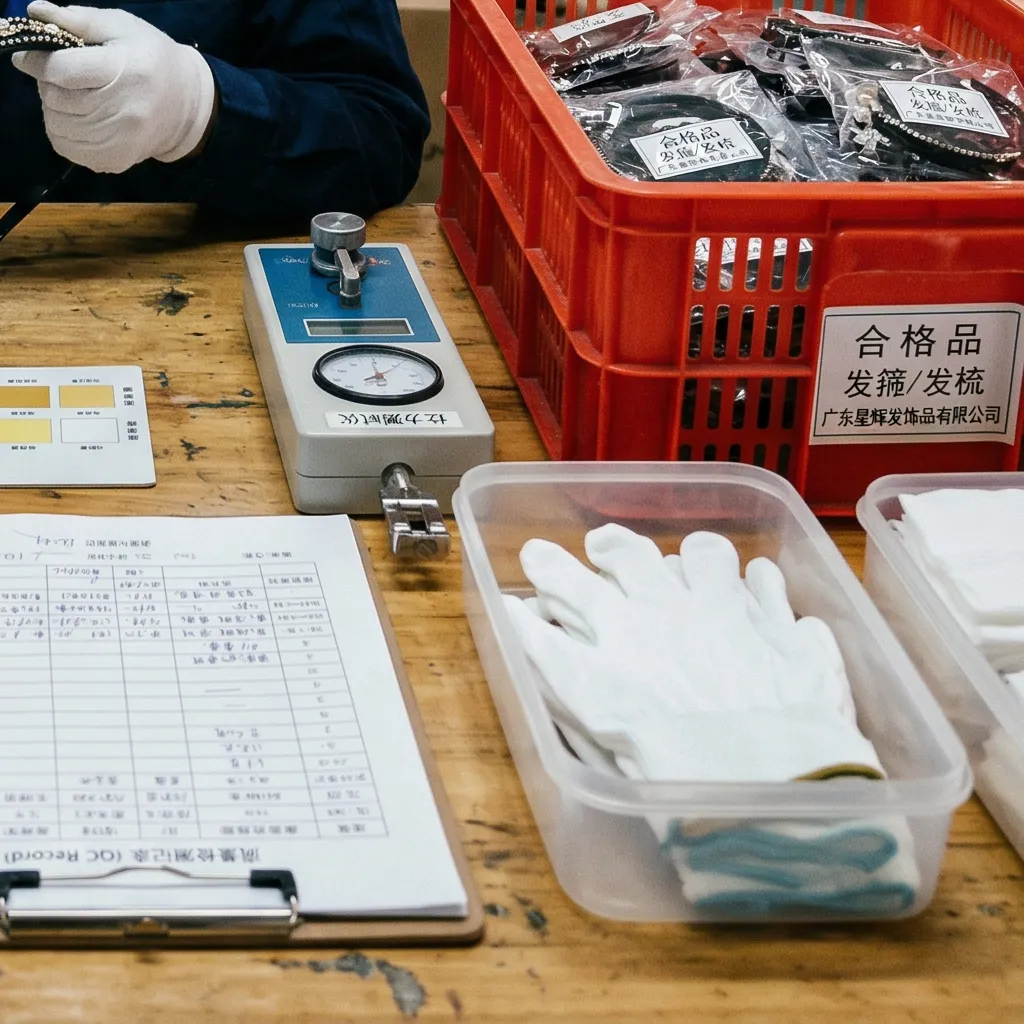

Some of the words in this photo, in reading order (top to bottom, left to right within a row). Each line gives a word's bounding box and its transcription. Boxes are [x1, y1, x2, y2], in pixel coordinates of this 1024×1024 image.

[855, 323, 982, 359] 合格品
[844, 366, 986, 399] 发箍/发梳
[821, 405, 1002, 428] 广东星辉发饰品有限公司
